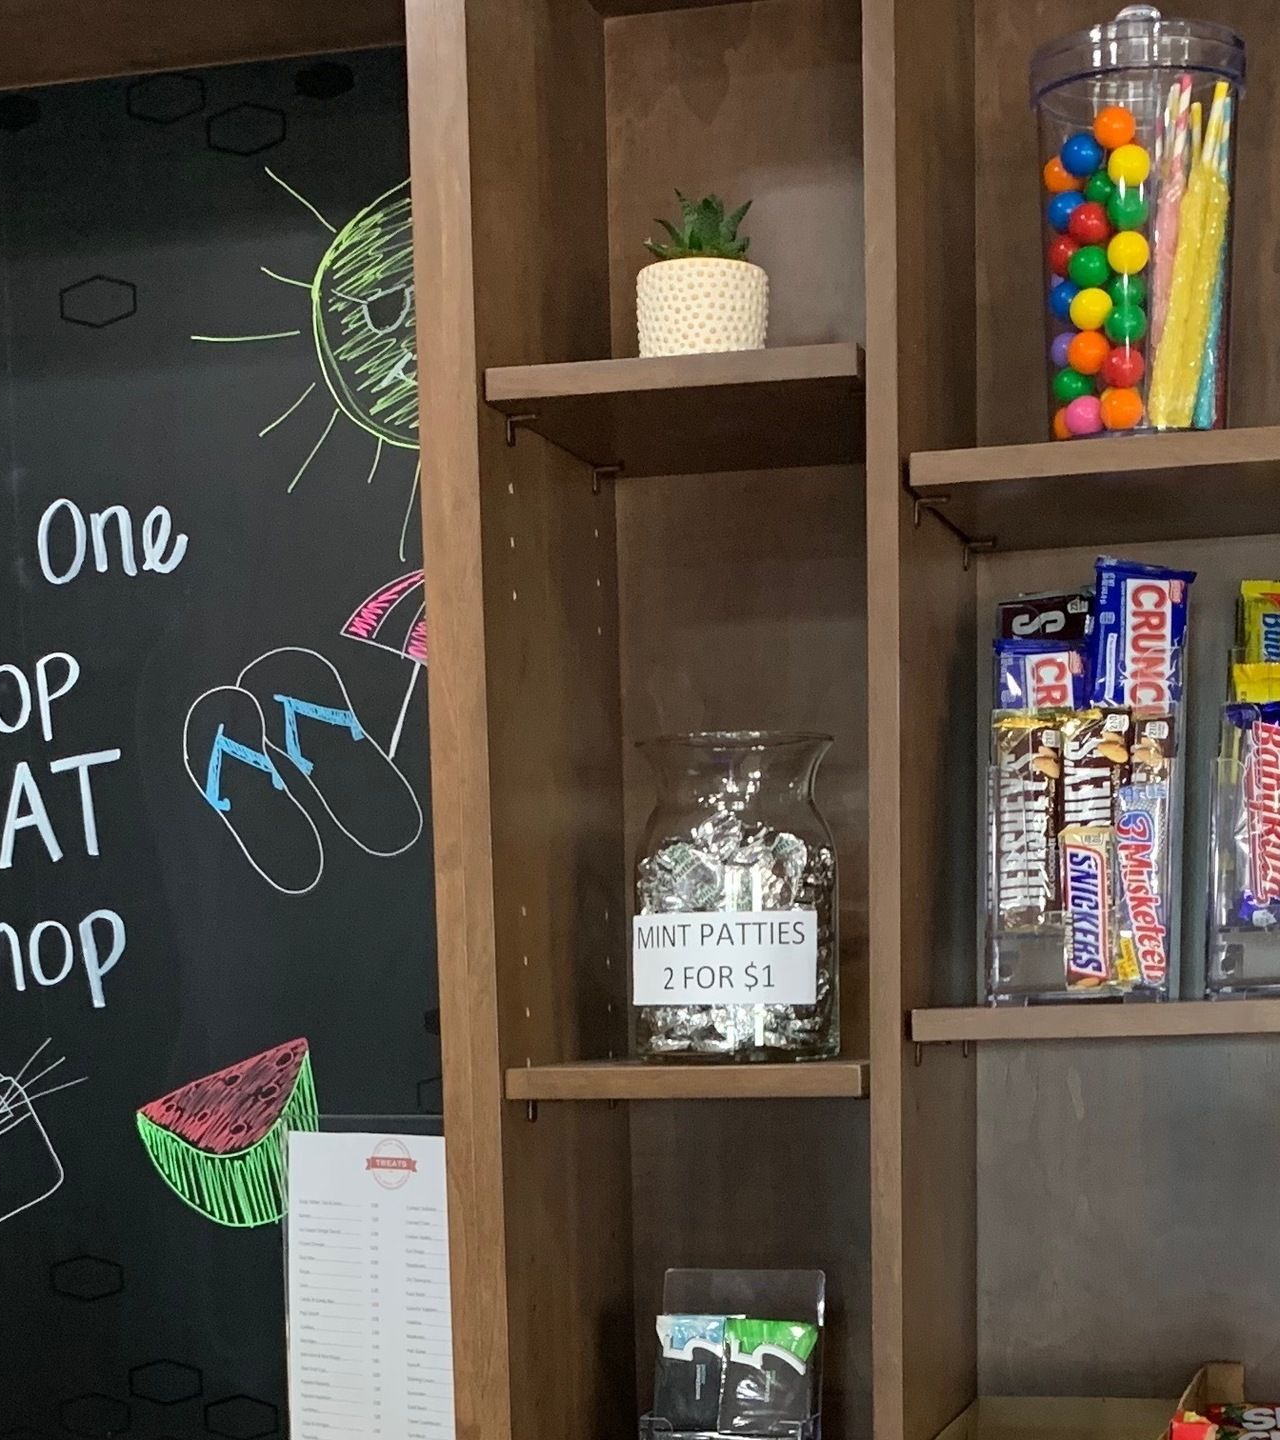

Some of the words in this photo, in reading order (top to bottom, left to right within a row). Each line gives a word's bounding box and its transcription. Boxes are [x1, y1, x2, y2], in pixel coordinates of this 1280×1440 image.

[1070, 852, 1102, 973] SNICKERS
[637, 924, 691, 949] MINT
[701, 921, 806, 946] PATTIES
[664, 966, 674, 990] 2
[683, 965, 734, 989] FOR
[744, 961, 775, 991] $1
